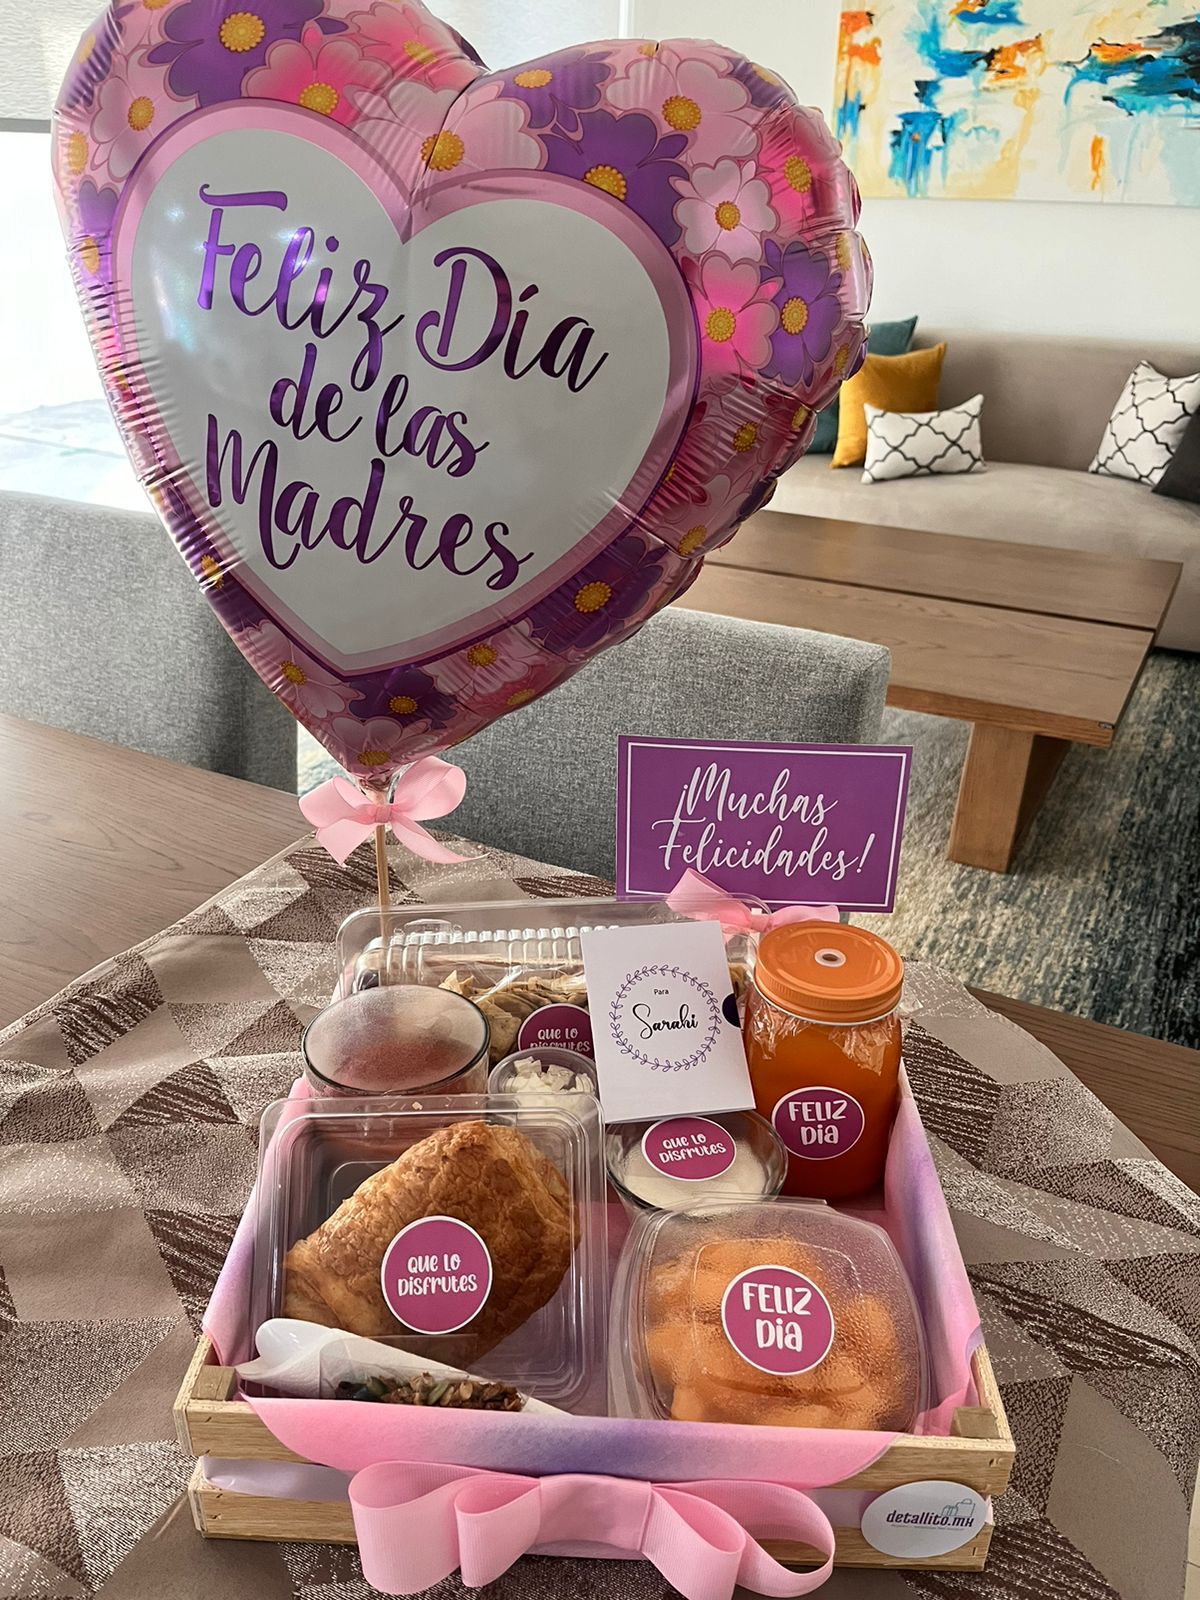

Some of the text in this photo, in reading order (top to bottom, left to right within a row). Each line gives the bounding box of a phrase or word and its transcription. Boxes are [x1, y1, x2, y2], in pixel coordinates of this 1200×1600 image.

[197, 184, 609, 393] Feliz Día
[269, 343, 489, 477] de las
[207, 413, 534, 590] Madres
[652, 817, 875, 881] Felicidades!
[788, 1100, 848, 1122] FELIZ
[742, 1282, 812, 1315] FELIZ
[886, 1510, 975, 1528] detallito.mx
